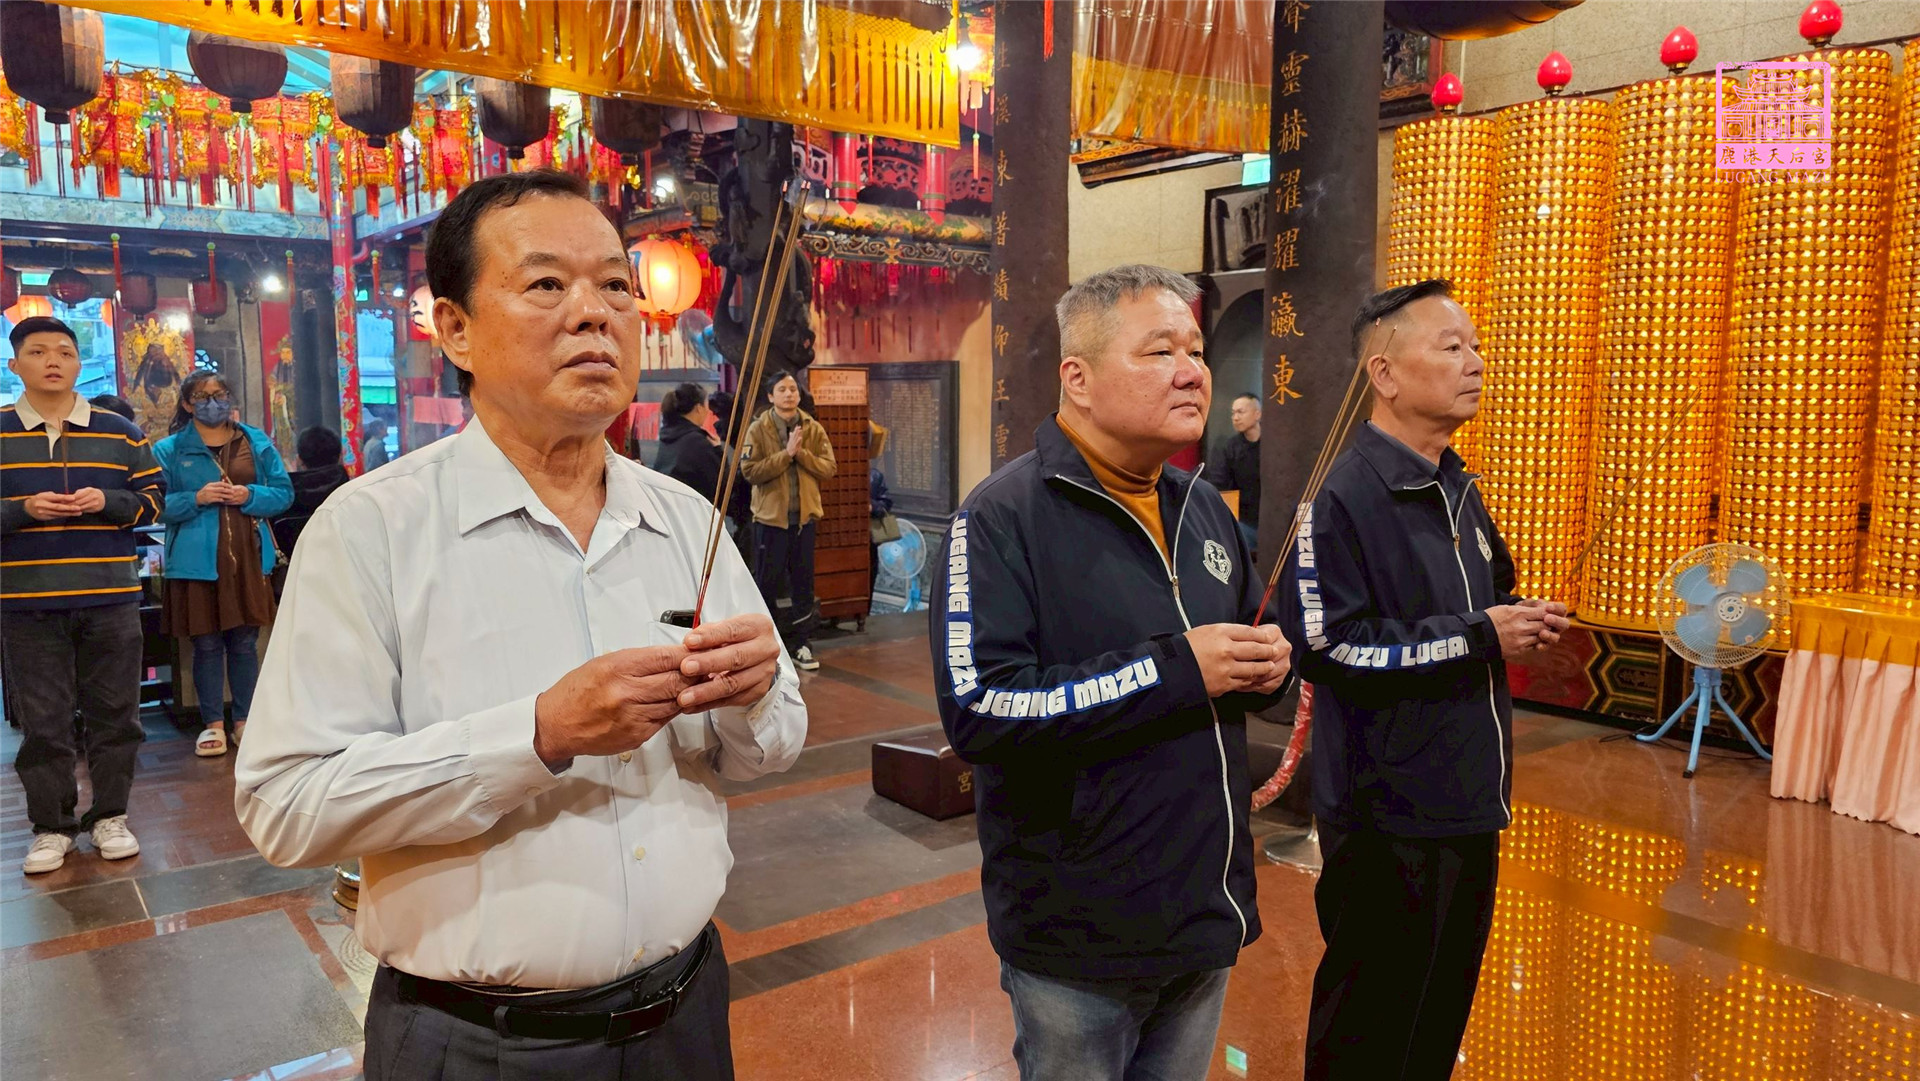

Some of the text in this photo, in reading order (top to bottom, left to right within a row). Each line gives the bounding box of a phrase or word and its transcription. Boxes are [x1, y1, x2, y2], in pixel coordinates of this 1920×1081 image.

[948, 514, 970, 613] UGANG
[1400, 635, 1470, 667] LUGA
[1073, 657, 1159, 710] MAZU
[957, 770, 972, 793] 宮
